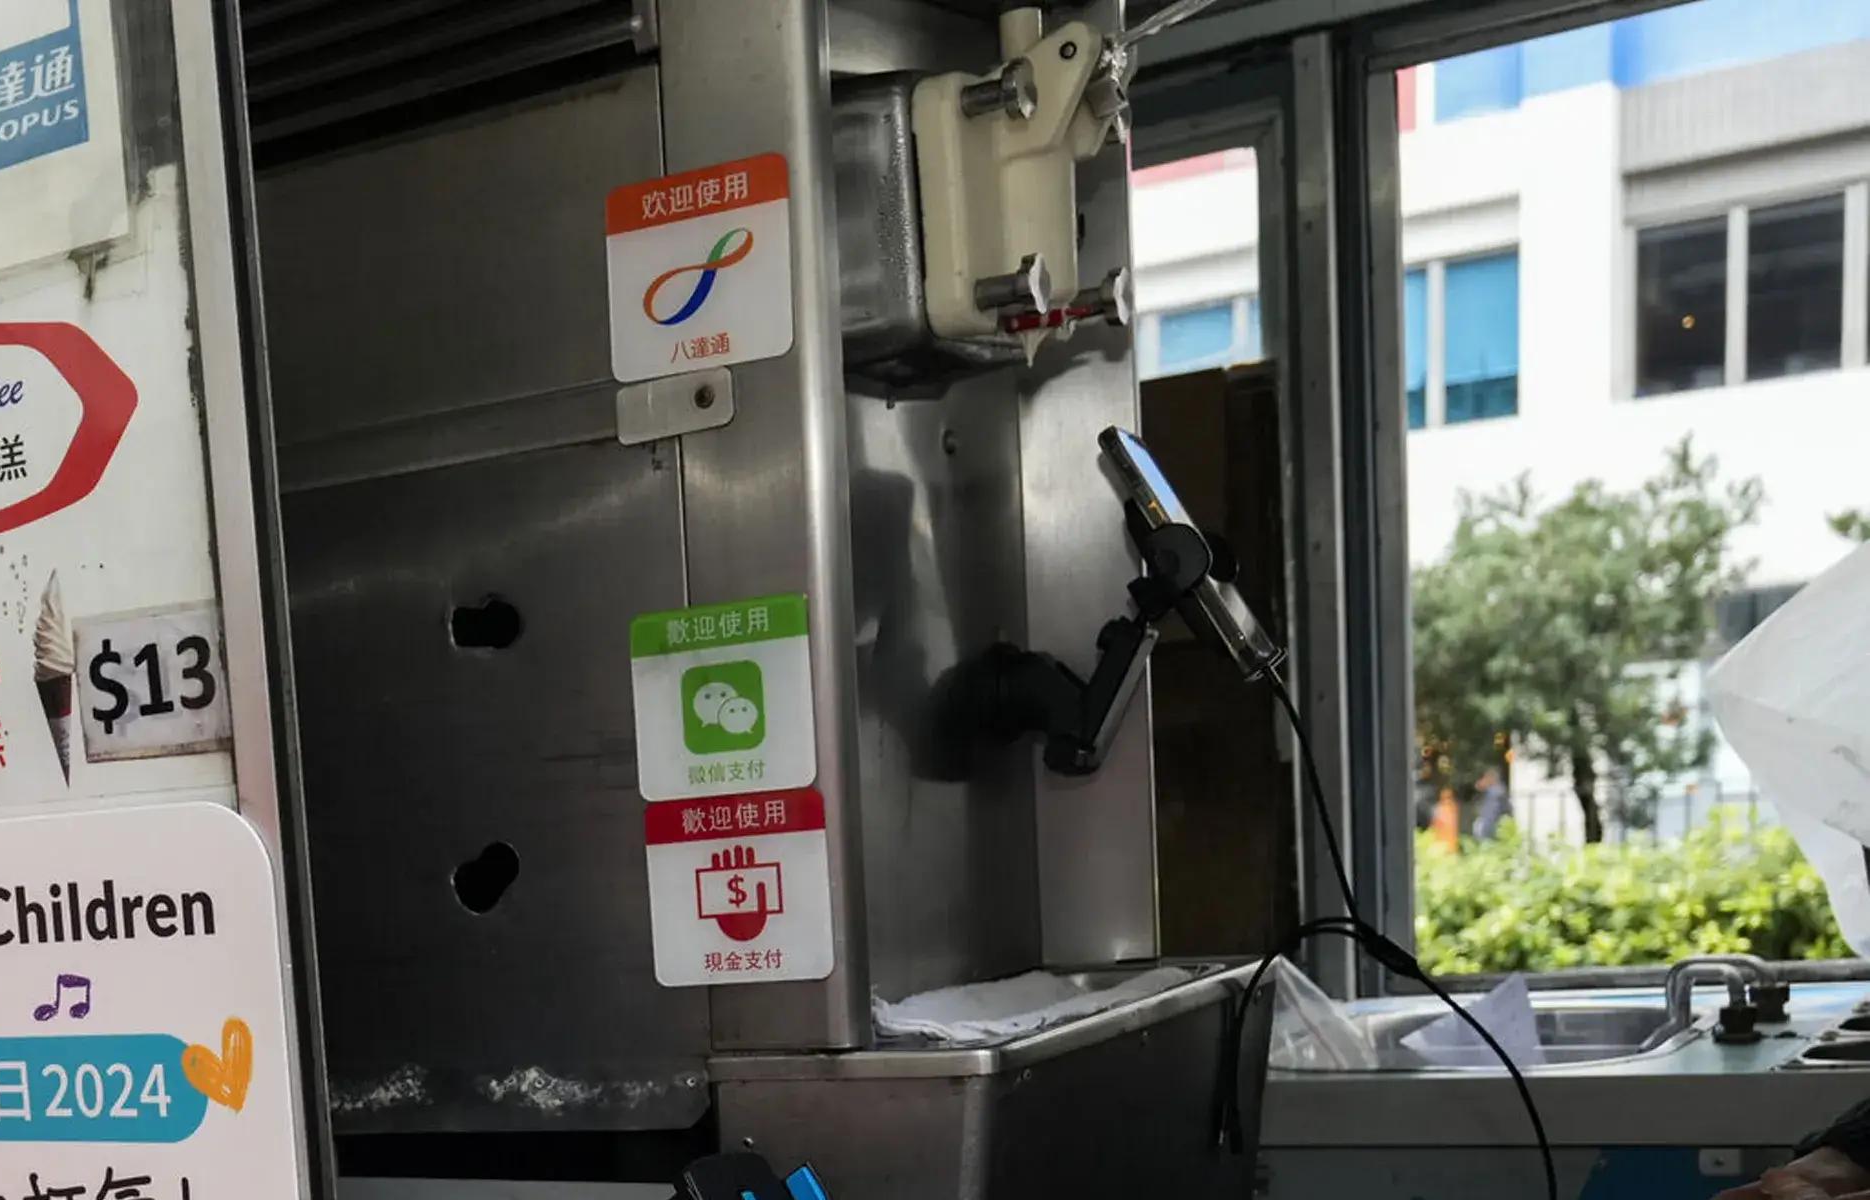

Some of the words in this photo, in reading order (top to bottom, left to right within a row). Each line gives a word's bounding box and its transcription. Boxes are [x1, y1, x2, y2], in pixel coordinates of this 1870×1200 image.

[641, 171, 749, 220] 欢迎使用
[665, 605, 770, 645] 歡迎使用
[88, 634, 217, 735] $13
[681, 799, 787, 836] 歡迎使用
[703, 948, 783, 972] 現金支付
